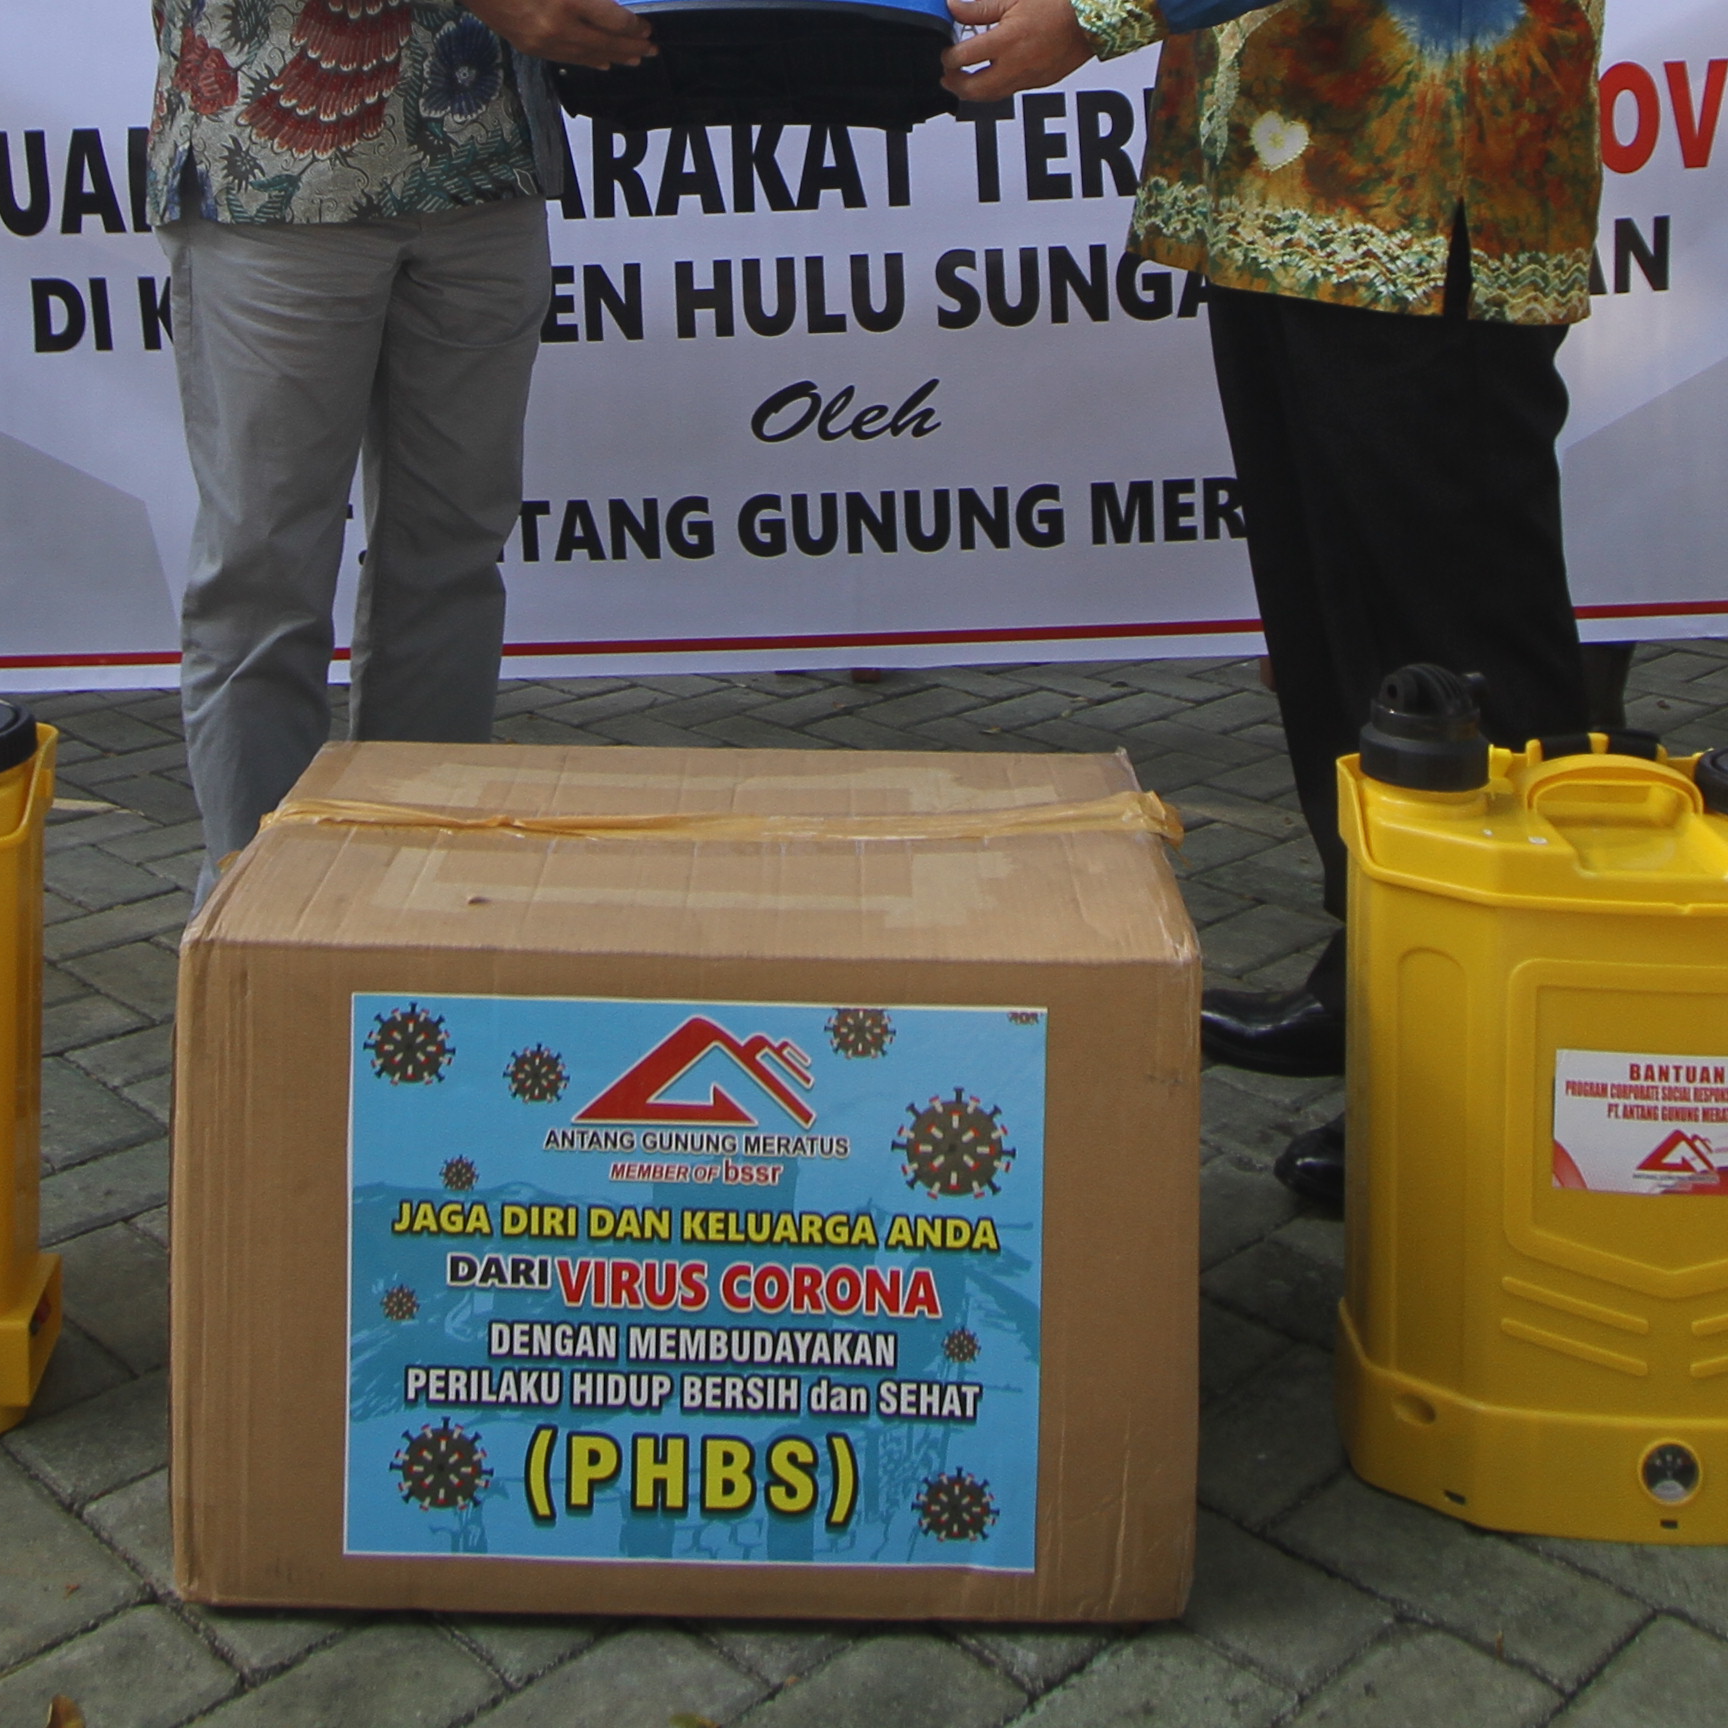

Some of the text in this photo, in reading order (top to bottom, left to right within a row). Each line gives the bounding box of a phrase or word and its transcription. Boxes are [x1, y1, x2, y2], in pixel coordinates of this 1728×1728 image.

[956, 87, 1155, 204] TER
[30, 276, 114, 353] DI
[674, 252, 910, 338] HULU
[750, 377, 943, 444] Oleh
[496, 476, 1248, 564] TANG GUNUNG MER
[1565, 1080, 1608, 1098] PROGRAM
[1629, 1063, 1726, 1084] BANTUAN
[1622, 1104, 1660, 1121] ANTANG
[1661, 1105, 1700, 1123] GUNUNG
[544, 1129, 850, 1159] ANTANG GUNUNG MERATUS
[609, 1158, 783, 1185] MEMBER OF bssr
[392, 1200, 1000, 1252] JAGA DIRI DAN KELUARGA ANDA
[447, 1251, 943, 1319] DARI VIRUS CORONA
[489, 1322, 897, 1367] DENGAN MEMBUDAYAKAN
[406, 1367, 981, 1419] PERILAKU HIDUP BERSIH dan SEHAT
[527, 1427, 857, 1526] (PHBS)
